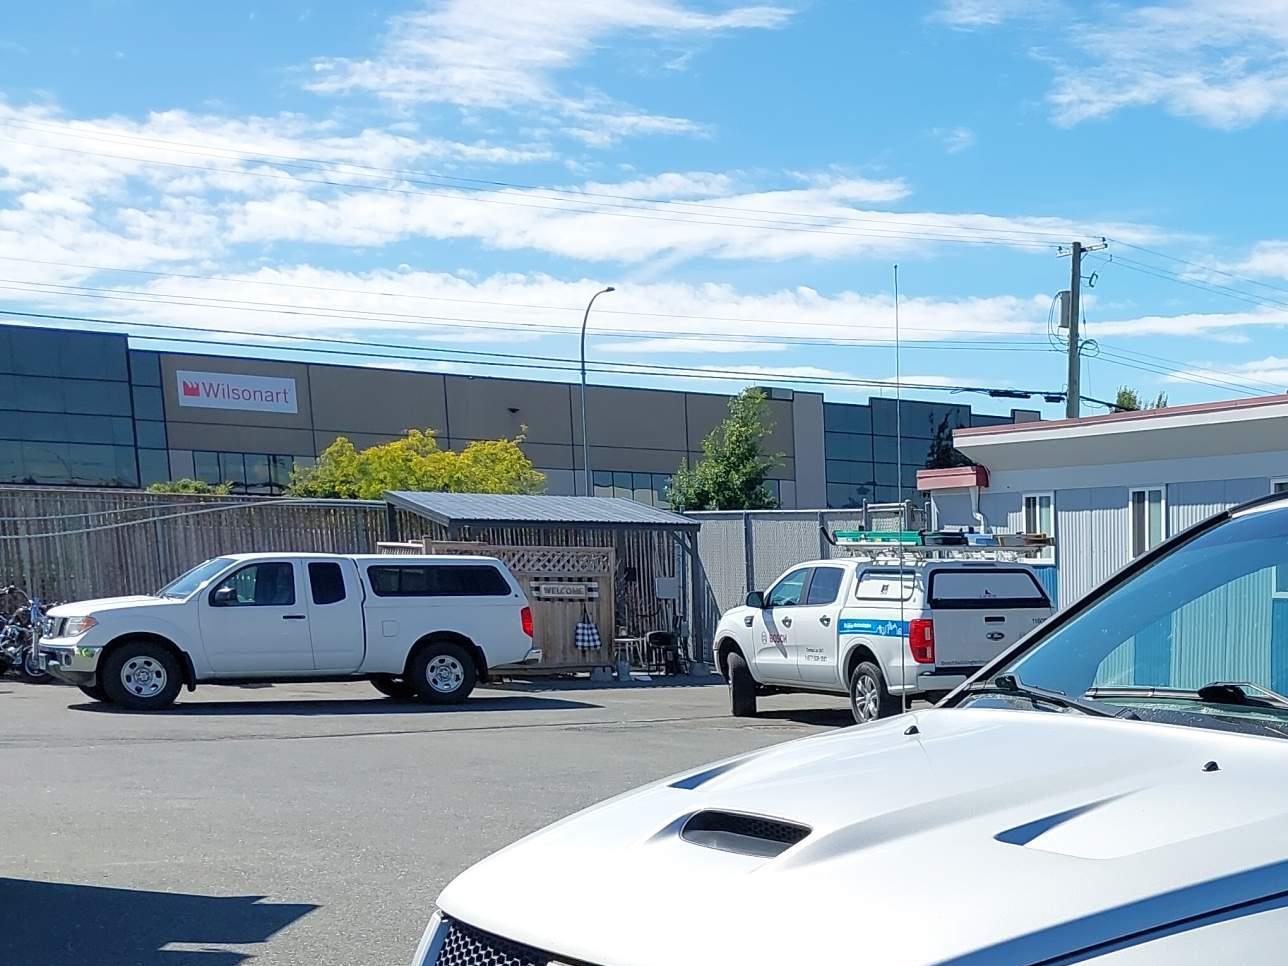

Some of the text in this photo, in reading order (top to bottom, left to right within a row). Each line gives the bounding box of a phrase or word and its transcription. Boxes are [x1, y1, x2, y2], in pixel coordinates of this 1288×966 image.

[201, 382, 289, 403] Wilsonart
[543, 586, 585, 595] WELCOME
[769, 633, 788, 644] BOSCH
